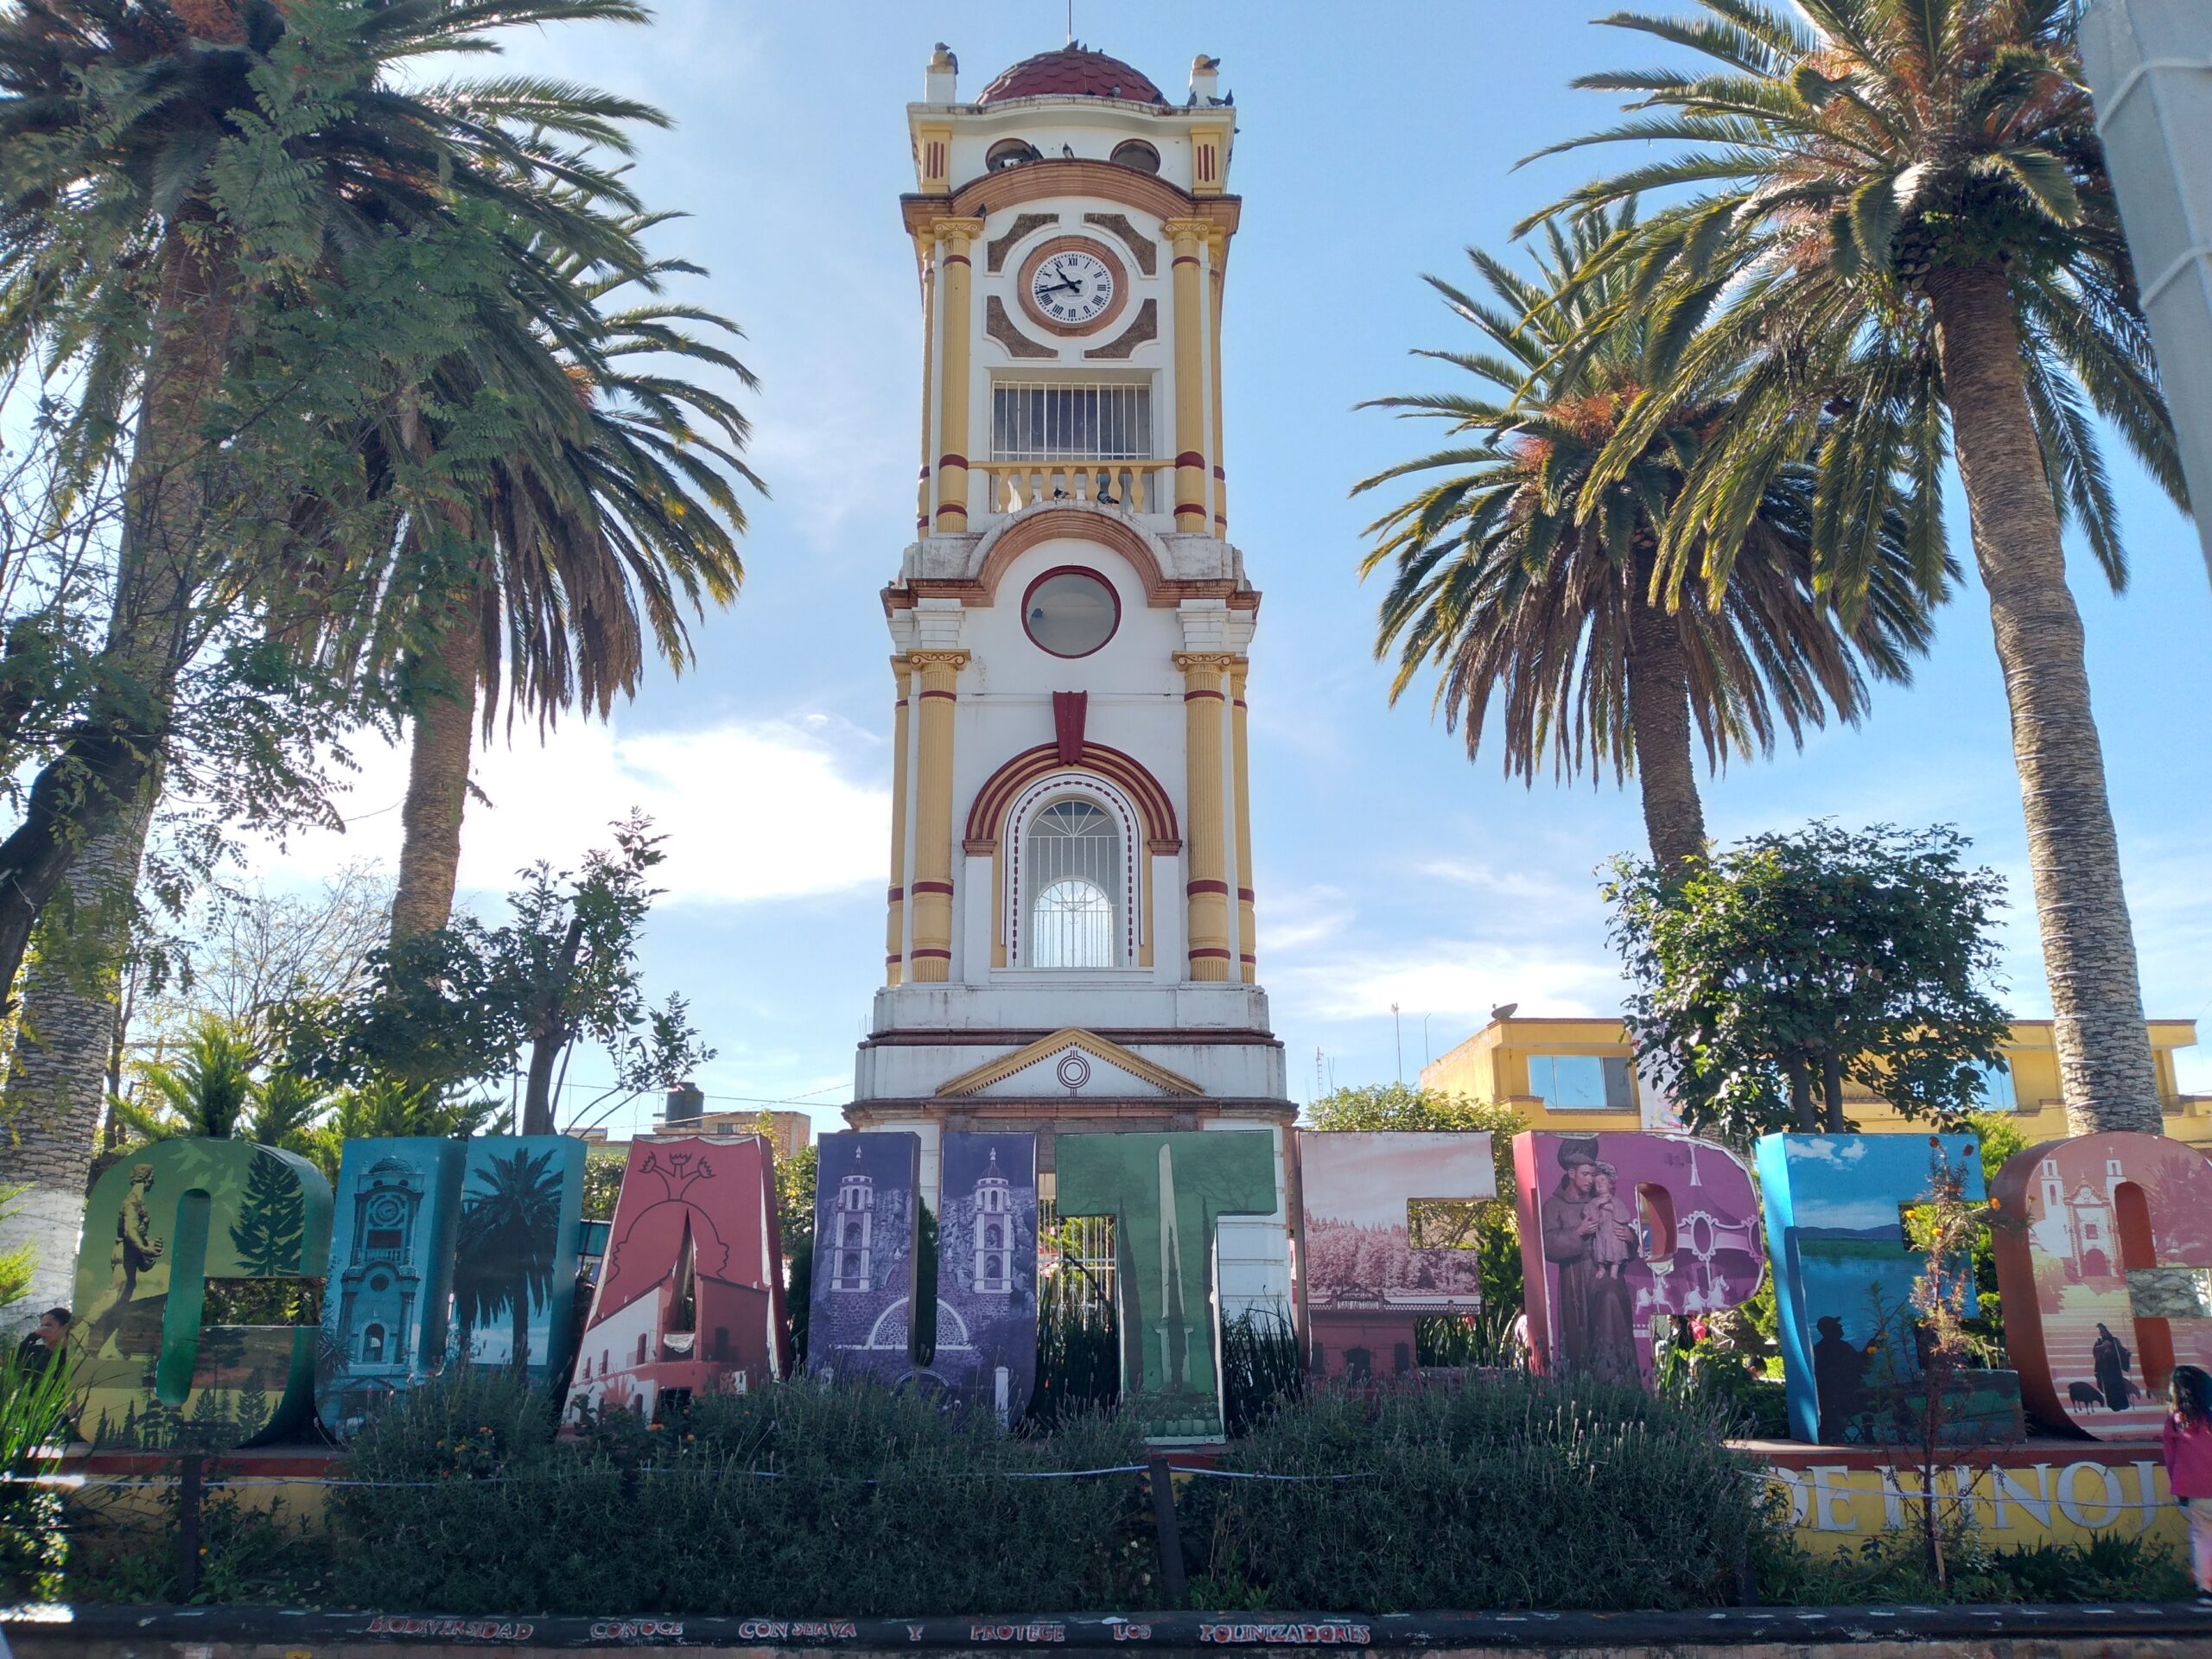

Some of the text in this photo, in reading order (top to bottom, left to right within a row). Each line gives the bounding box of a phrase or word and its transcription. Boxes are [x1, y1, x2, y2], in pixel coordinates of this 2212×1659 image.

[1068, 257, 1077, 266] XII
[1874, 1460, 2199, 1535] HINOJ
[367, 1618, 534, 1640] BIODIVERSIDAD
[590, 1622, 684, 1639] CONOCE
[907, 1624, 925, 1641] Y
[969, 1624, 1065, 1642] PROTEGE
[1112, 1624, 1152, 1641] LOS
[1199, 1624, 1370, 1644] POLINIZADORES
